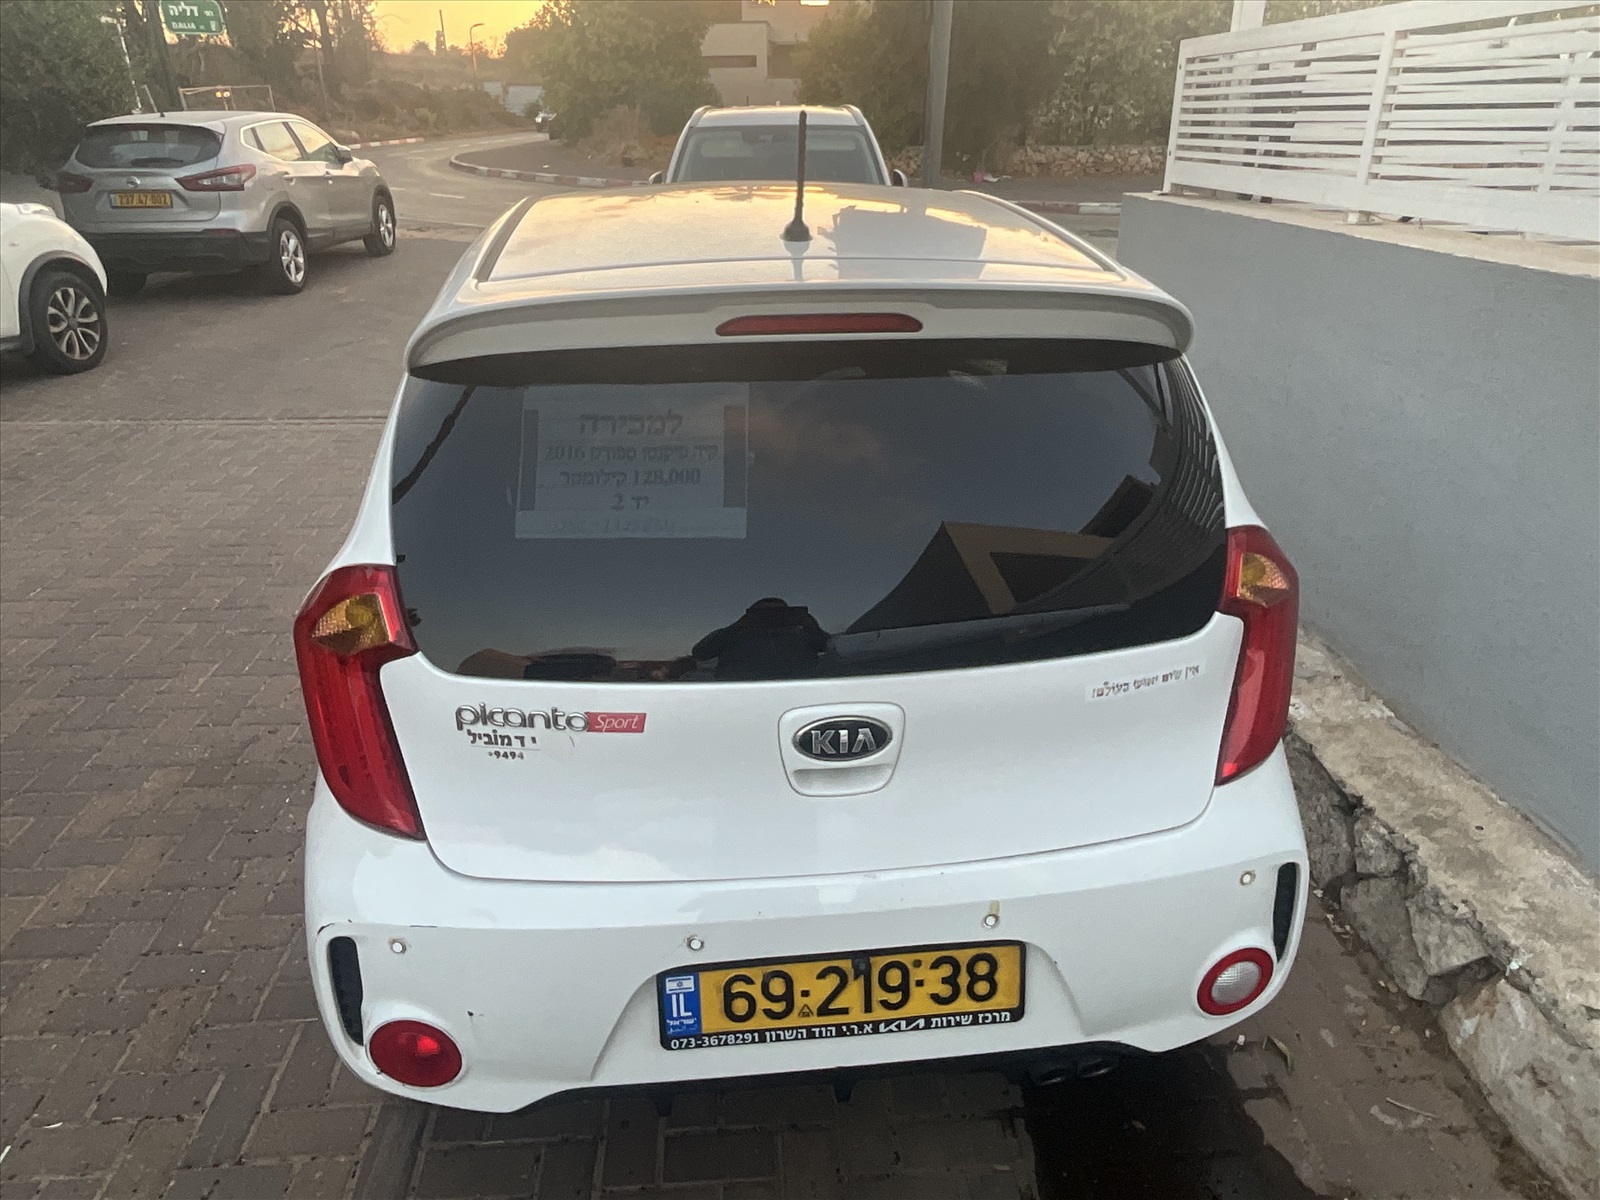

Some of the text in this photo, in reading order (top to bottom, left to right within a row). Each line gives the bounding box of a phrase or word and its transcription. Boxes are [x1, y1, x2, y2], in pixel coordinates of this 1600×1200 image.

[168, 1, 199, 17] דליה
[171, 21, 197, 30] DALIA
[579, 408, 684, 435] למכירה
[544, 444, 586, 462] 2016
[610, 492, 650, 511] יד 2
[1161, 669, 1183, 683] שום
[1184, 665, 1200, 680] אין
[455, 702, 639, 733] picanto Sport
[466, 728, 513, 747] מוביל
[811, 727, 877, 755] KIA
[671, 993, 693, 1018] IL
[930, 1015, 973, 1028] שירות
[978, 1011, 1011, 1024] מרכז
[764, 1028, 808, 1043] השרון
[811, 1026, 837, 1039] הוד
[670, 1033, 760, 1050] 073-3678291
